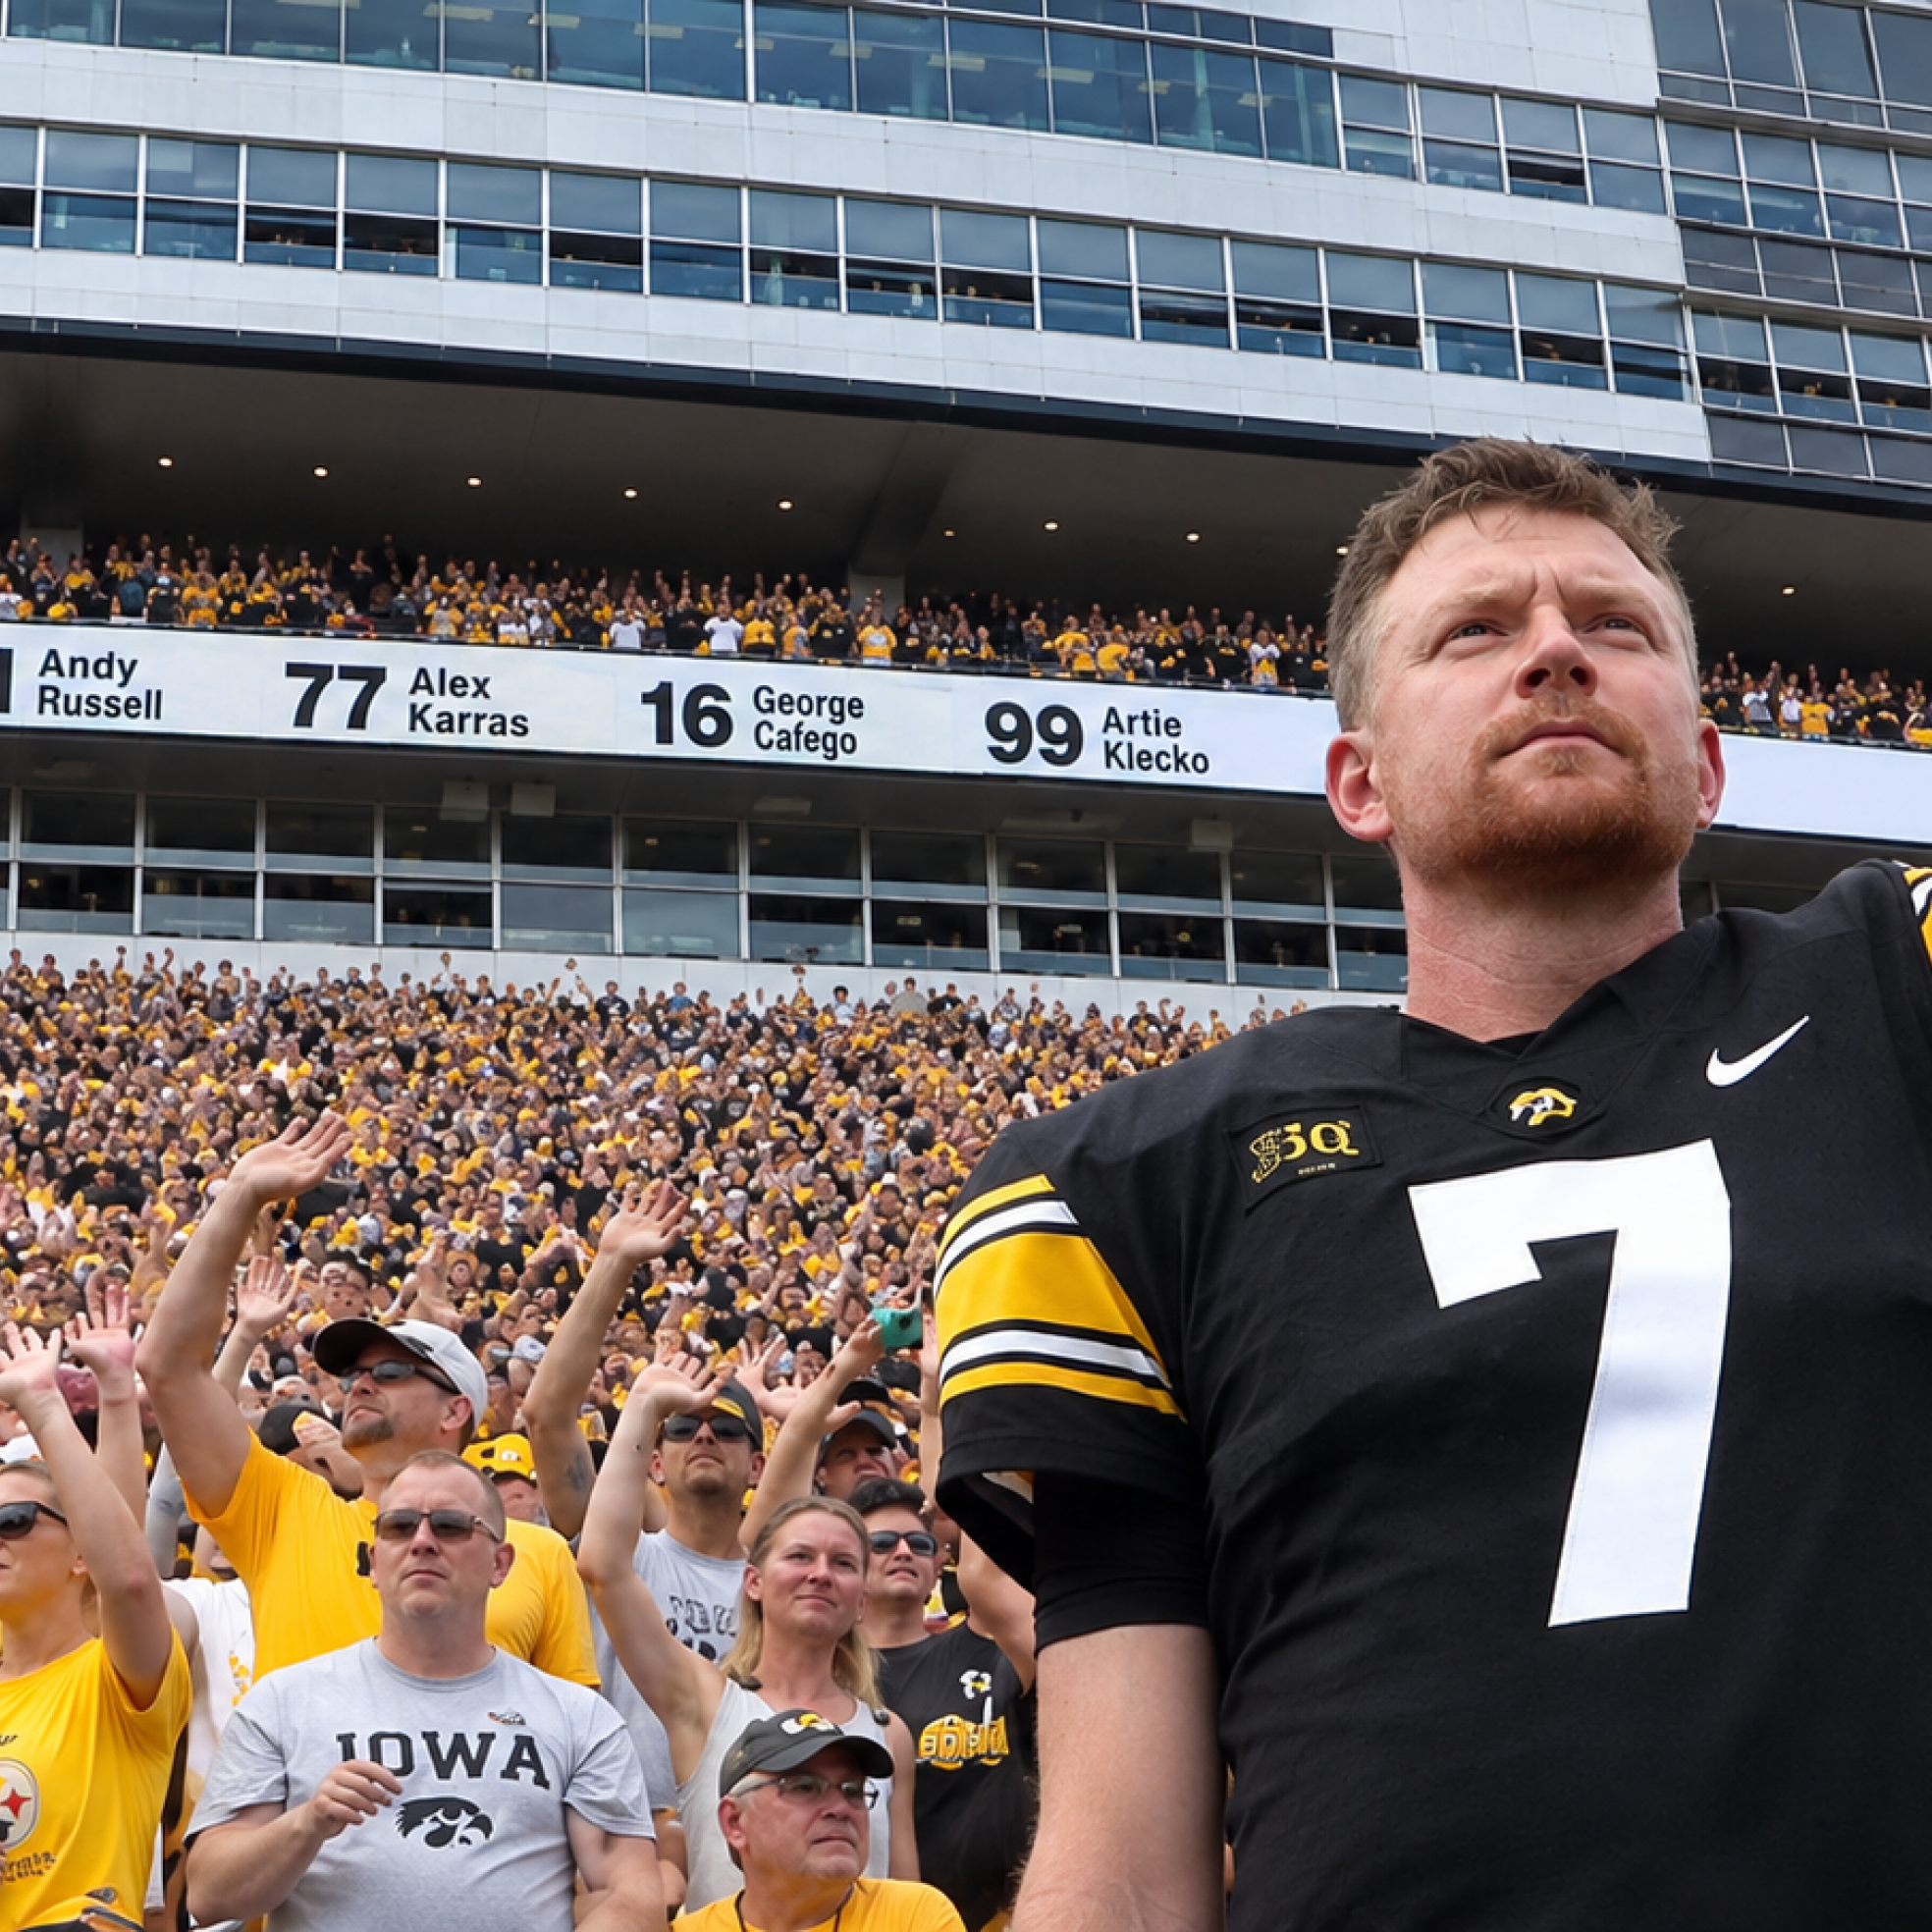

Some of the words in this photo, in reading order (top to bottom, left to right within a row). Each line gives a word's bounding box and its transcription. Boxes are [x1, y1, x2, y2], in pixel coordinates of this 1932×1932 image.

[38, 648, 138, 688] Andy
[408, 666, 491, 700] Alex
[38, 684, 162, 721] Russell
[285, 662, 388, 729] 77
[640, 680, 733, 748] 16
[753, 684, 864, 725] George
[408, 702, 529, 737] Karras
[984, 701, 1084, 766] 99
[1101, 706, 1182, 737] Artie
[753, 720, 857, 761] Cafego
[1103, 739, 1209, 774] Klecko
[1408, 1137, 1733, 1628] 7
[336, 1731, 551, 1790] IOWA
